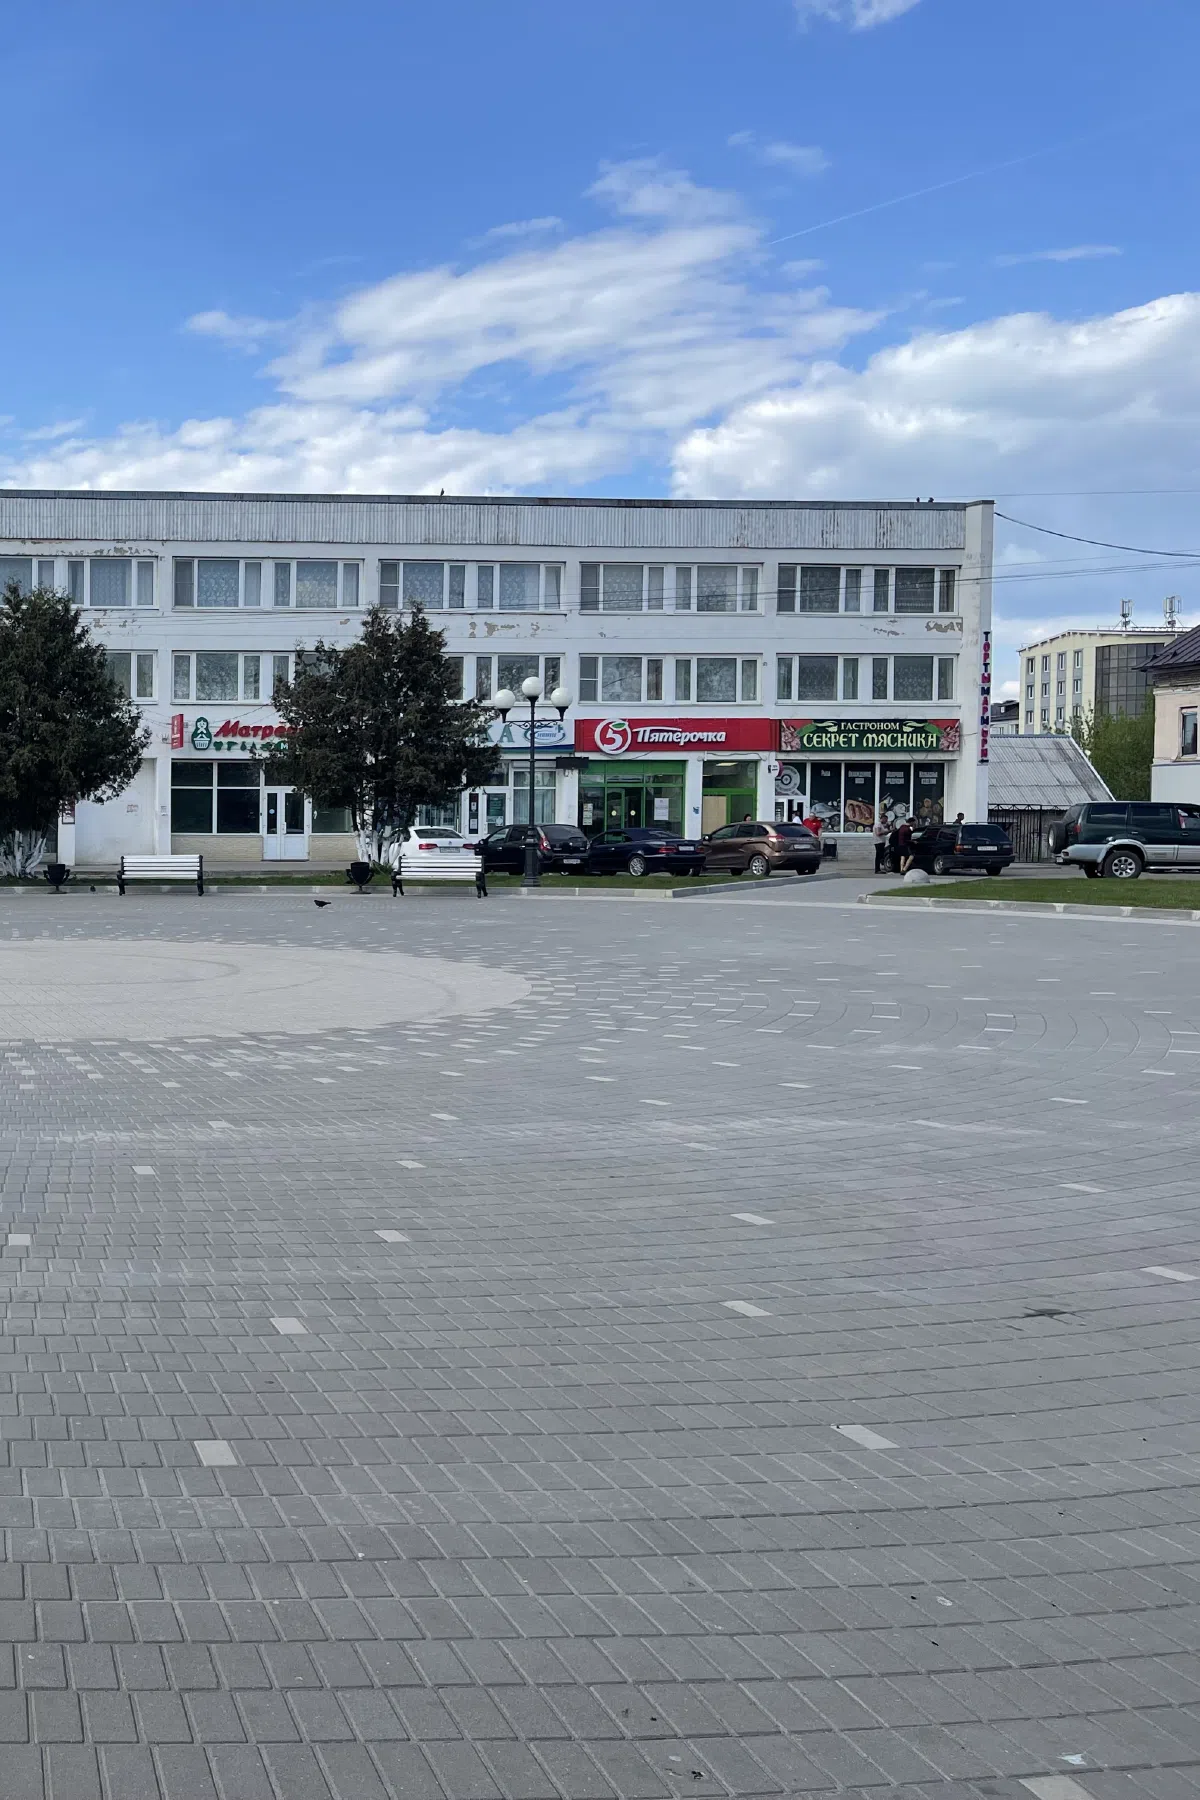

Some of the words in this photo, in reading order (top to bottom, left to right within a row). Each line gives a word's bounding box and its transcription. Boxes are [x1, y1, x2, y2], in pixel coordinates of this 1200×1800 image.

[841, 722, 900, 730] ГАСТРОНОМ
[632, 726, 726, 745] Пятерочка
[803, 733, 860, 748] СЕКРЕТ
[863, 733, 937, 748] МЯСНИКА
